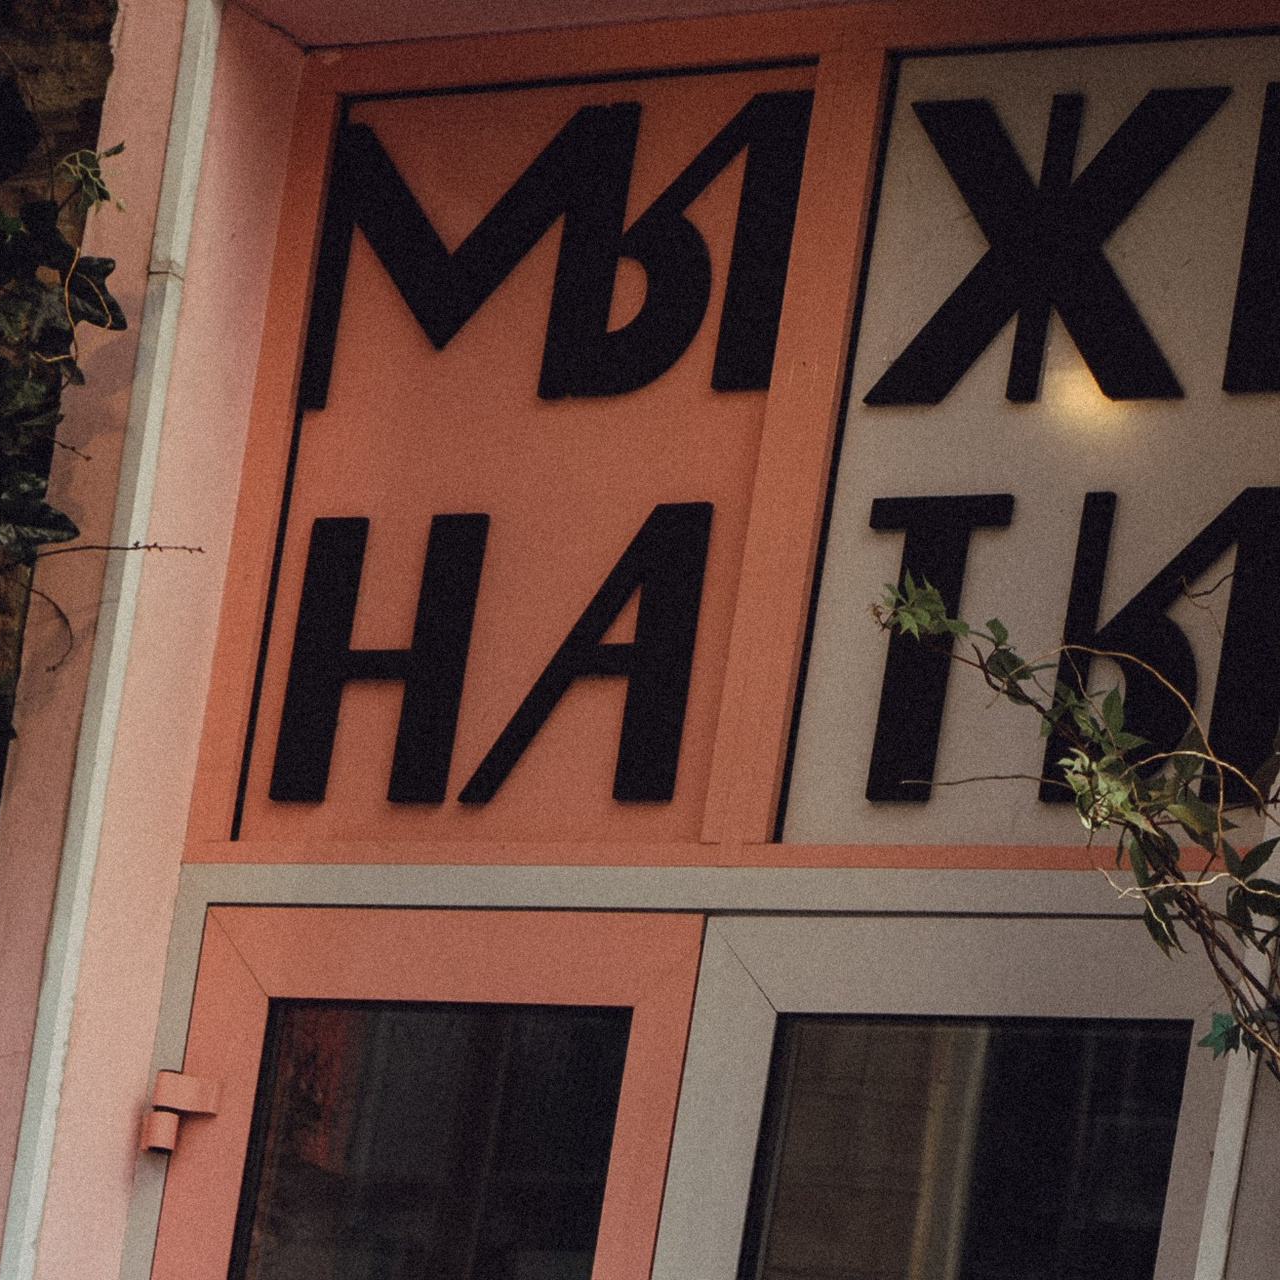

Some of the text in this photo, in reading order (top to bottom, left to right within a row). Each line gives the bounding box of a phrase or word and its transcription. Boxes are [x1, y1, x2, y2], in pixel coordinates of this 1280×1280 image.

[298, 88, 815, 411] МЫ
[268, 486, 1280, 805] НА ТЫ
